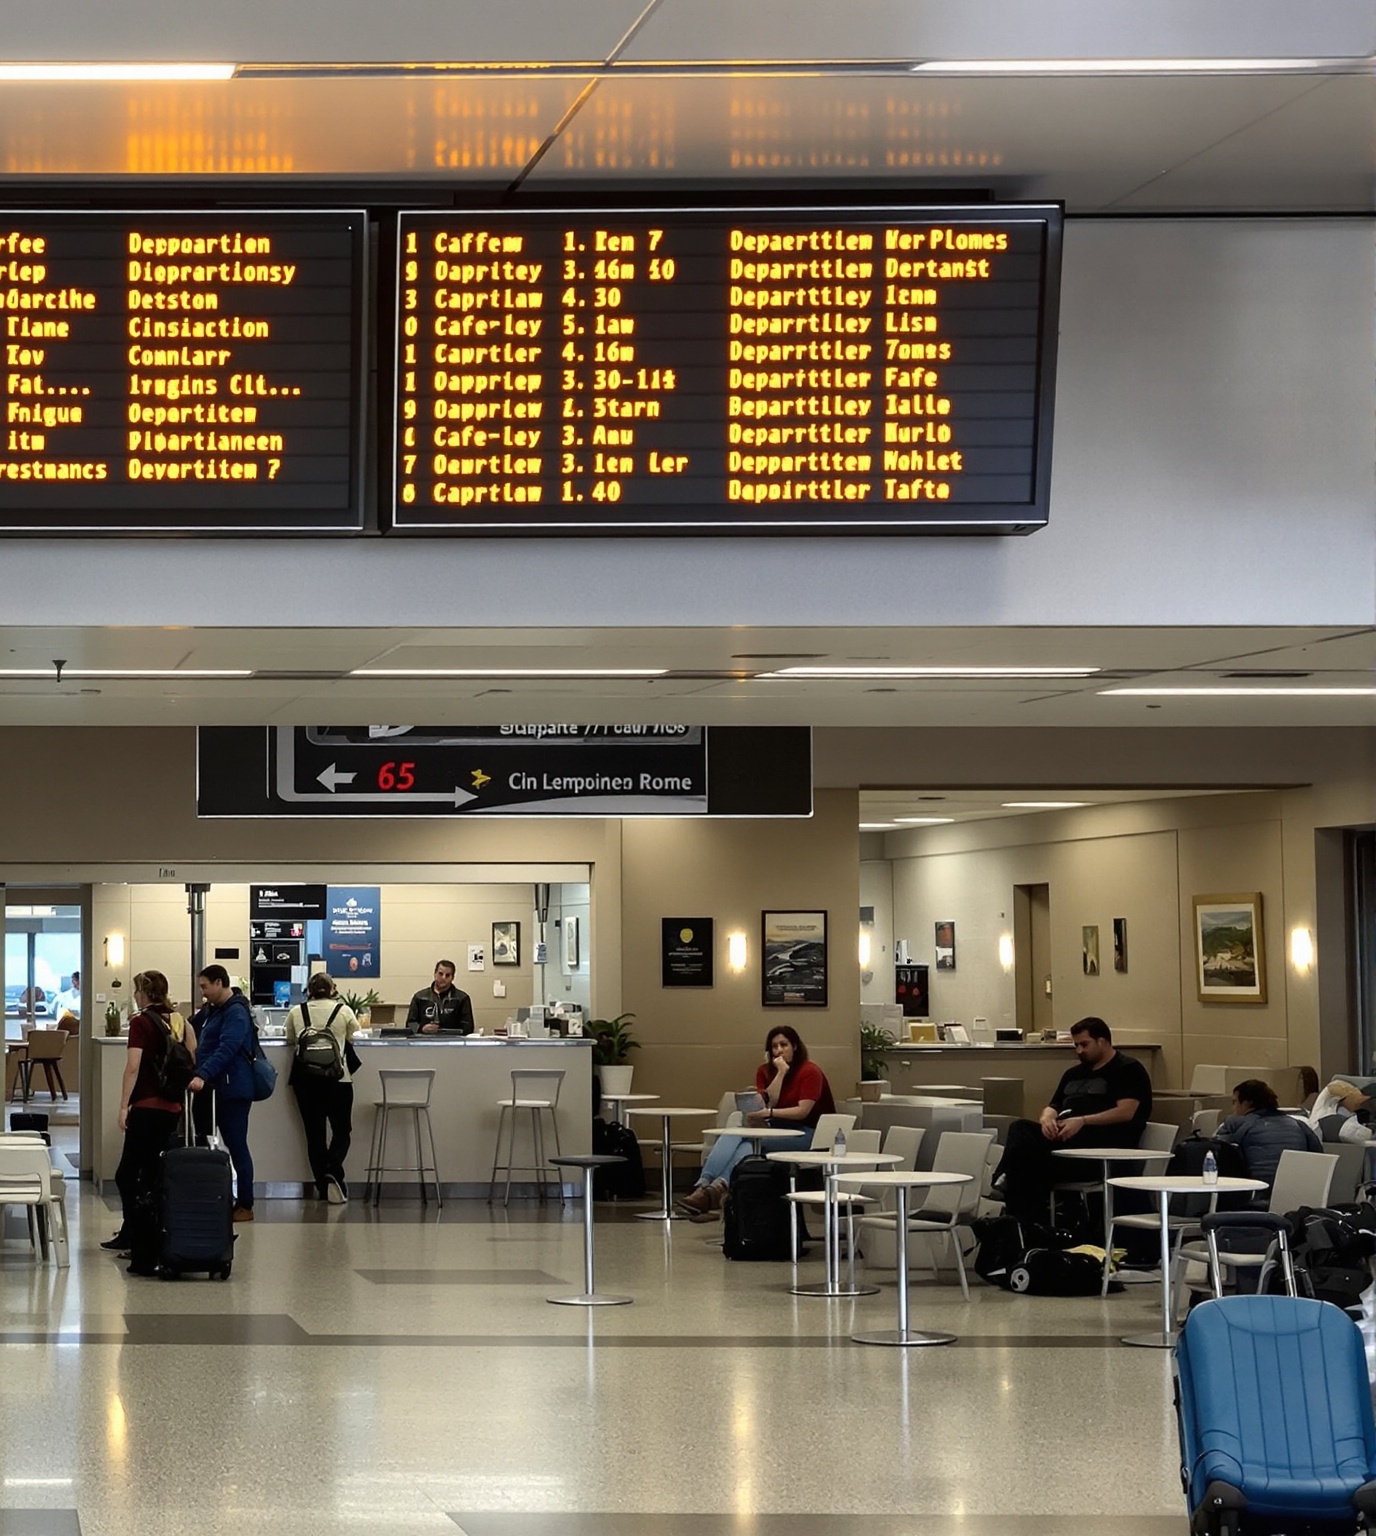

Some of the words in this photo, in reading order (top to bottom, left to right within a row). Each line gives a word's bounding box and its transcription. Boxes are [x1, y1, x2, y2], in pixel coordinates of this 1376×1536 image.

[406, 232, 418, 254] 1
[563, 231, 586, 252] 1.
[648, 229, 663, 251] 7
[563, 259, 585, 280] 3.
[404, 288, 417, 310] 3
[561, 287, 586, 308] 4.
[593, 287, 621, 308] 30
[563, 313, 585, 336] 5.
[404, 343, 417, 364] 1
[561, 341, 584, 362] 4.
[405, 371, 416, 392] 1
[561, 424, 584, 446] 3.
[403, 454, 417, 475] 7
[561, 452, 584, 474] 3.
[561, 480, 584, 502] 1.
[591, 480, 621, 502] 40
[377, 761, 415, 791] 65
[508, 772, 537, 790] Cin
[639, 773, 693, 790] Rome
